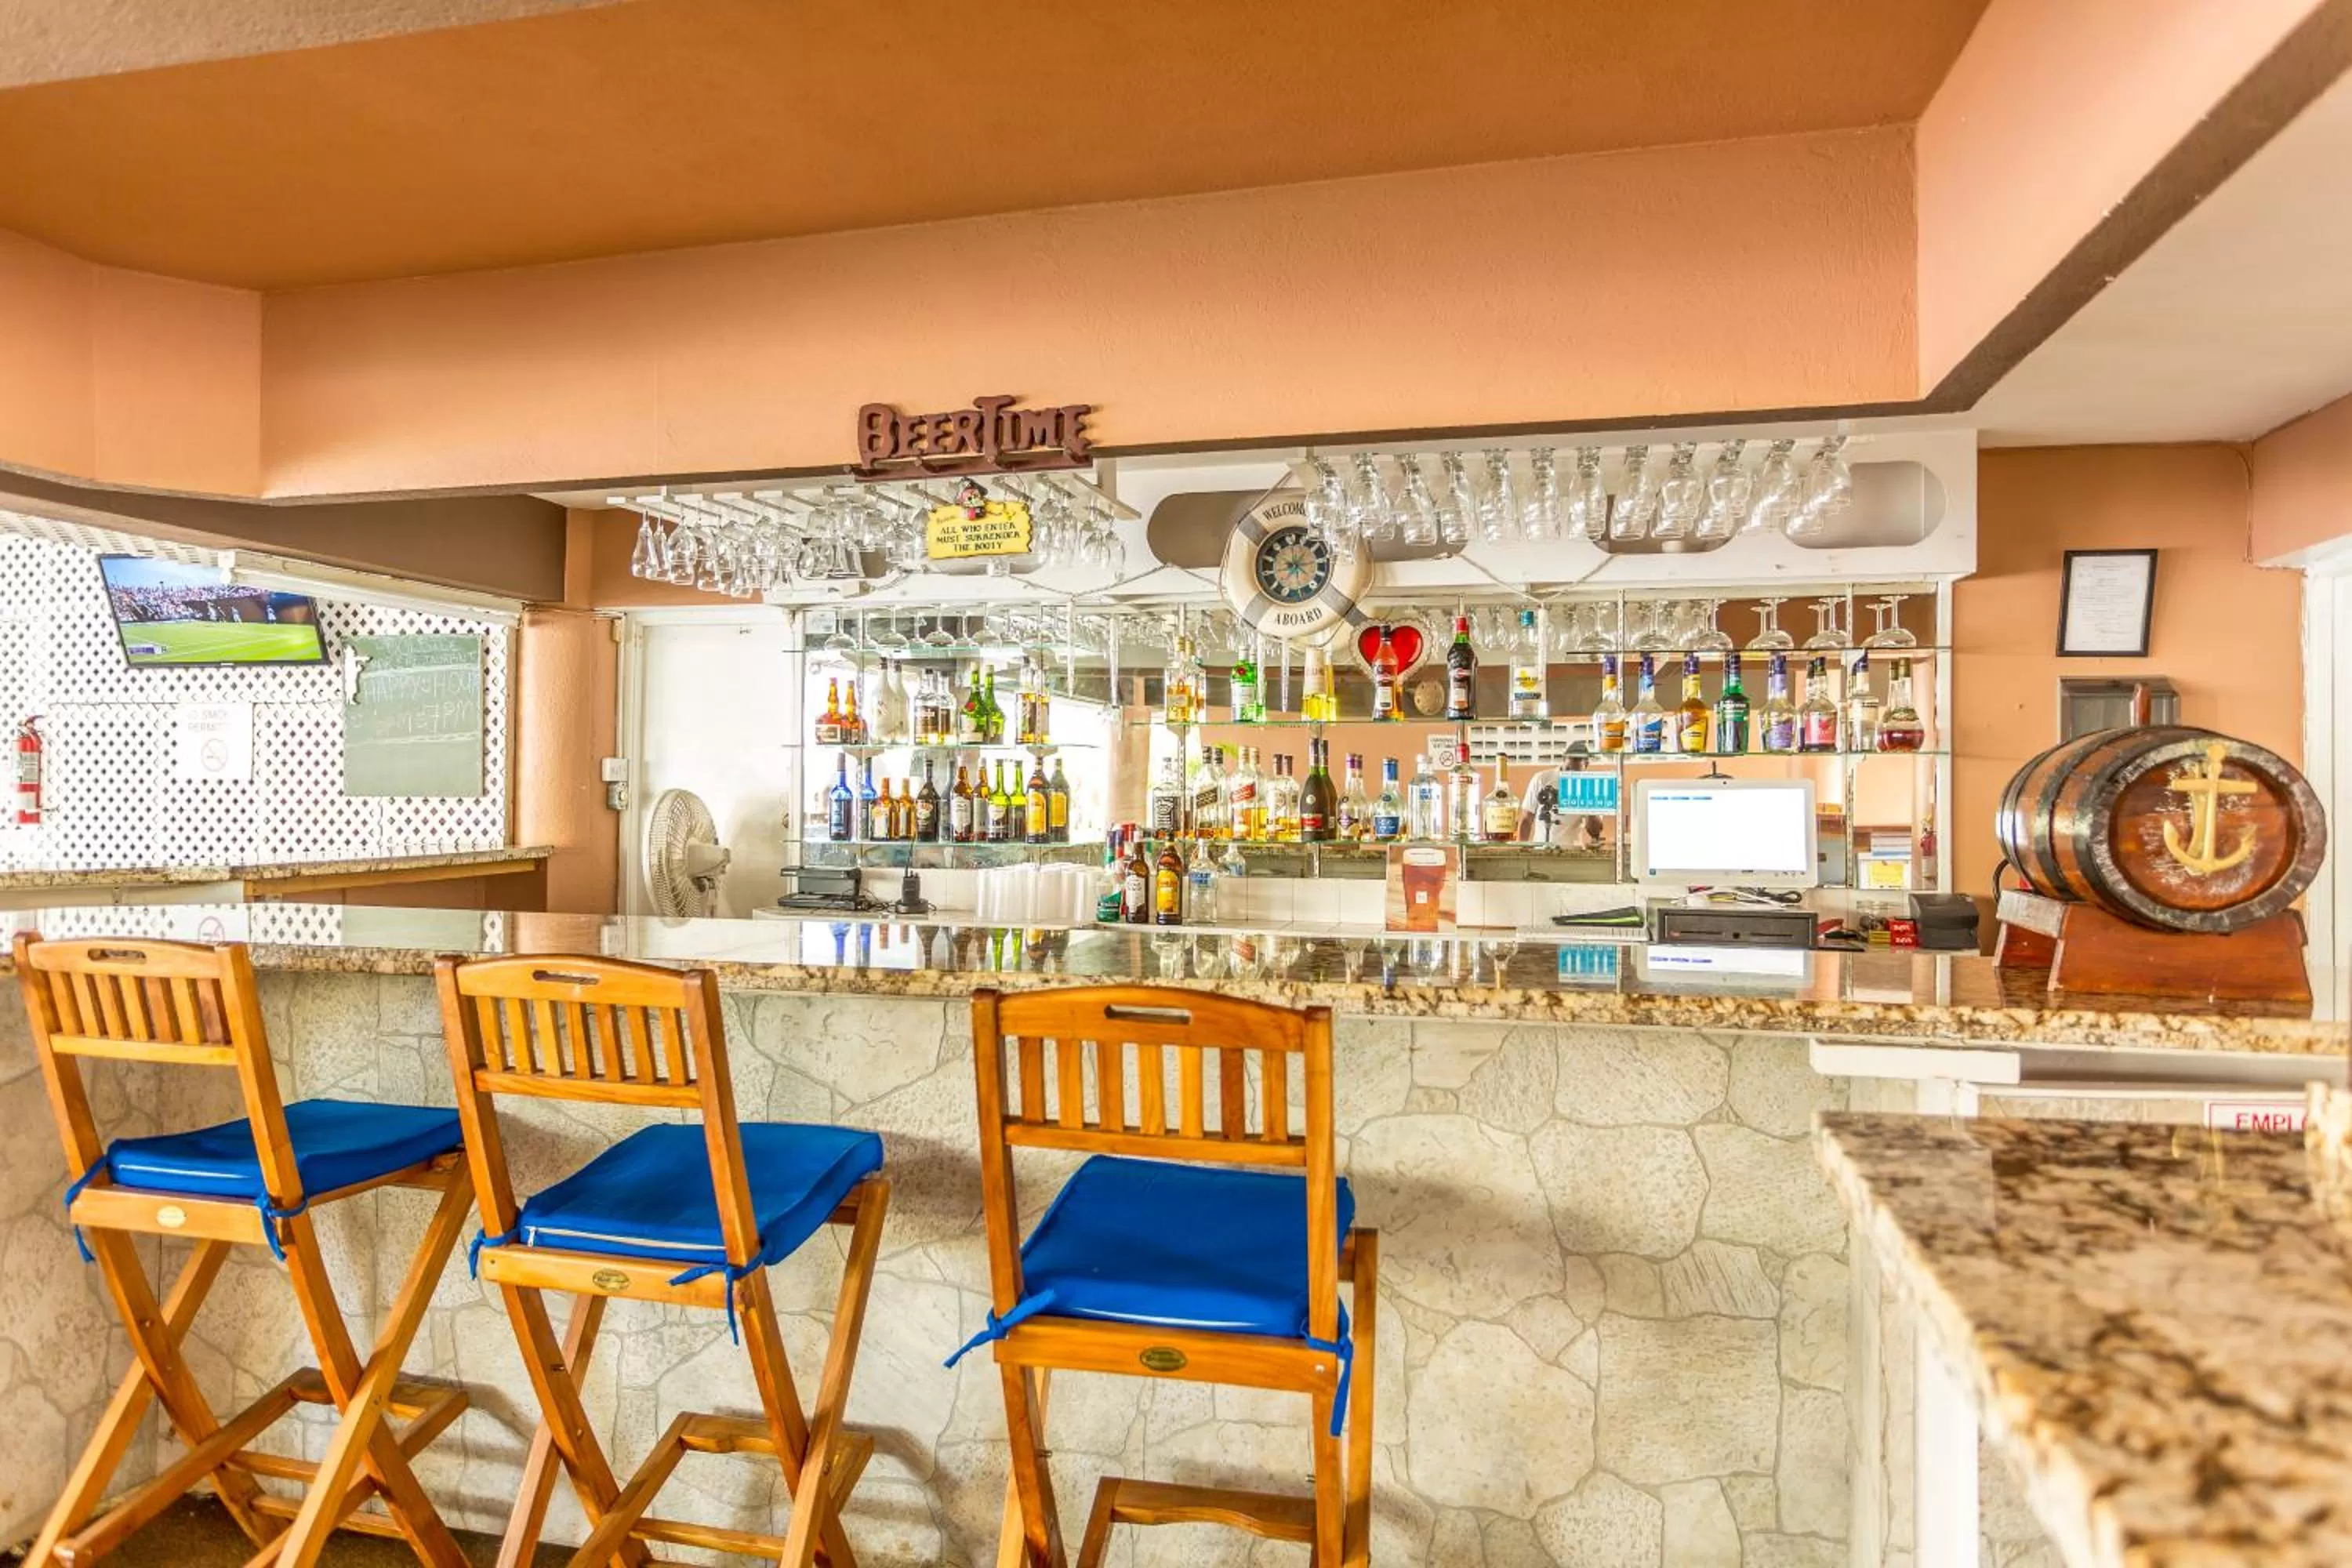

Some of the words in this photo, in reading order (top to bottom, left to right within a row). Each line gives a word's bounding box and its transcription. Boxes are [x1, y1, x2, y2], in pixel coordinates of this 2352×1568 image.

[1263, 501, 1306, 521] WELCOM
[941, 526, 957, 535] ALL
[961, 524, 982, 533] WHO
[984, 522, 1016, 532] ENTER
[936, 535, 960, 544] MUST
[964, 531, 1021, 543] SURRENDER
[953, 543, 970, 553] THE
[975, 542, 1004, 551] BOOTY
[1275, 607, 1323, 626] ABOARD
